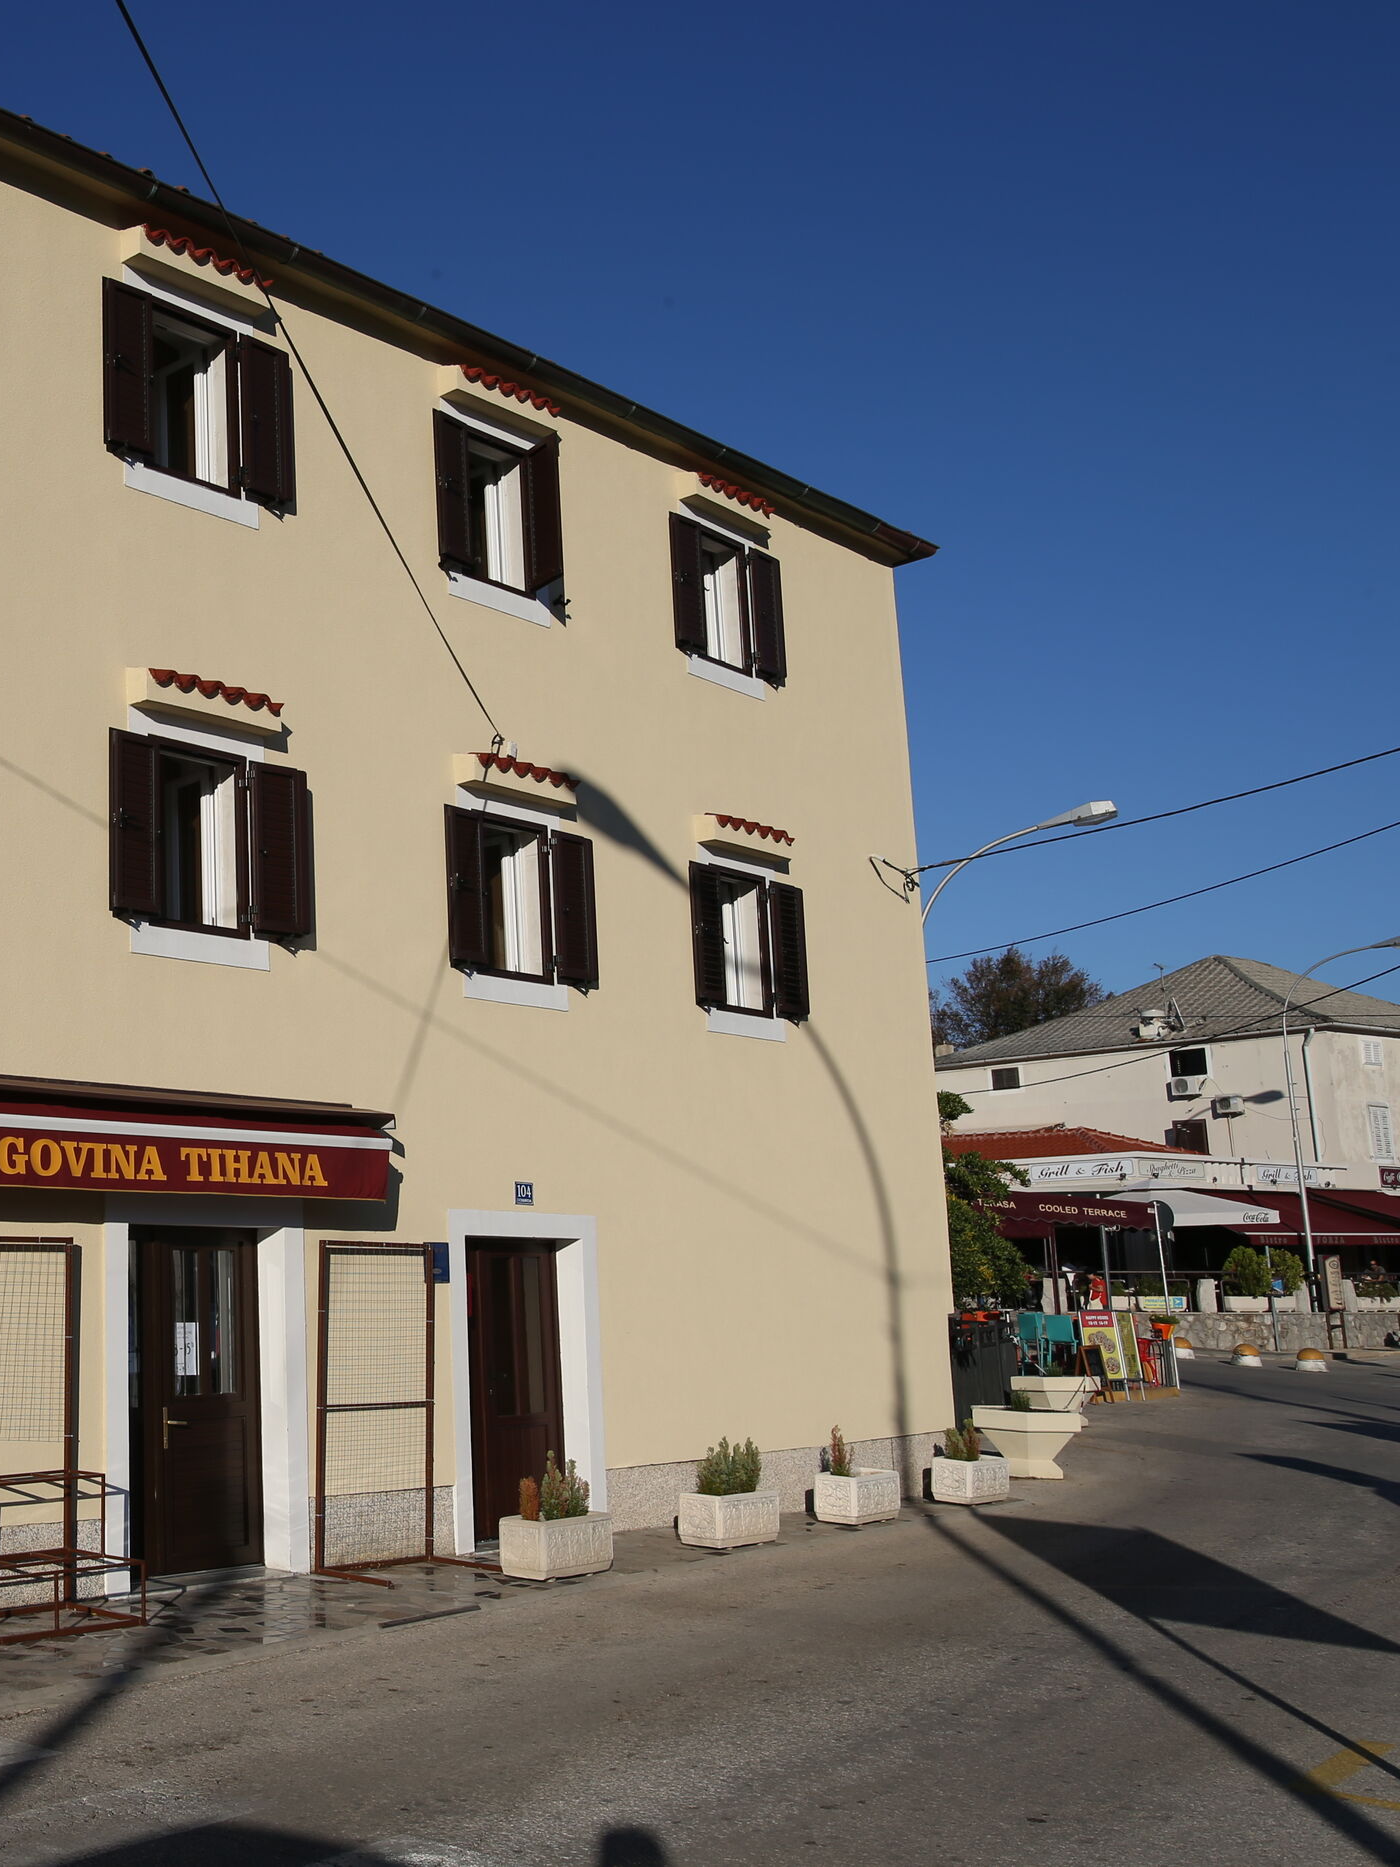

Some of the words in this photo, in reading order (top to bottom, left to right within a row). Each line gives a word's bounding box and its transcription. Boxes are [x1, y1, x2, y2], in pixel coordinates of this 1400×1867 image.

[180, 1146, 328, 1187] TIHANA
[1038, 1164, 1070, 1179] Grill
[1075, 1167, 1085, 1176] &
[1091, 1161, 1124, 1176] Fish
[1262, 1168, 1281, 1179] Grill
[517, 1184, 531, 1198] 104
[1038, 1203, 1078, 1215] COOLED
[1082, 1207, 1128, 1218] TERRACE
[1259, 1235, 1288, 1244] Bistro
